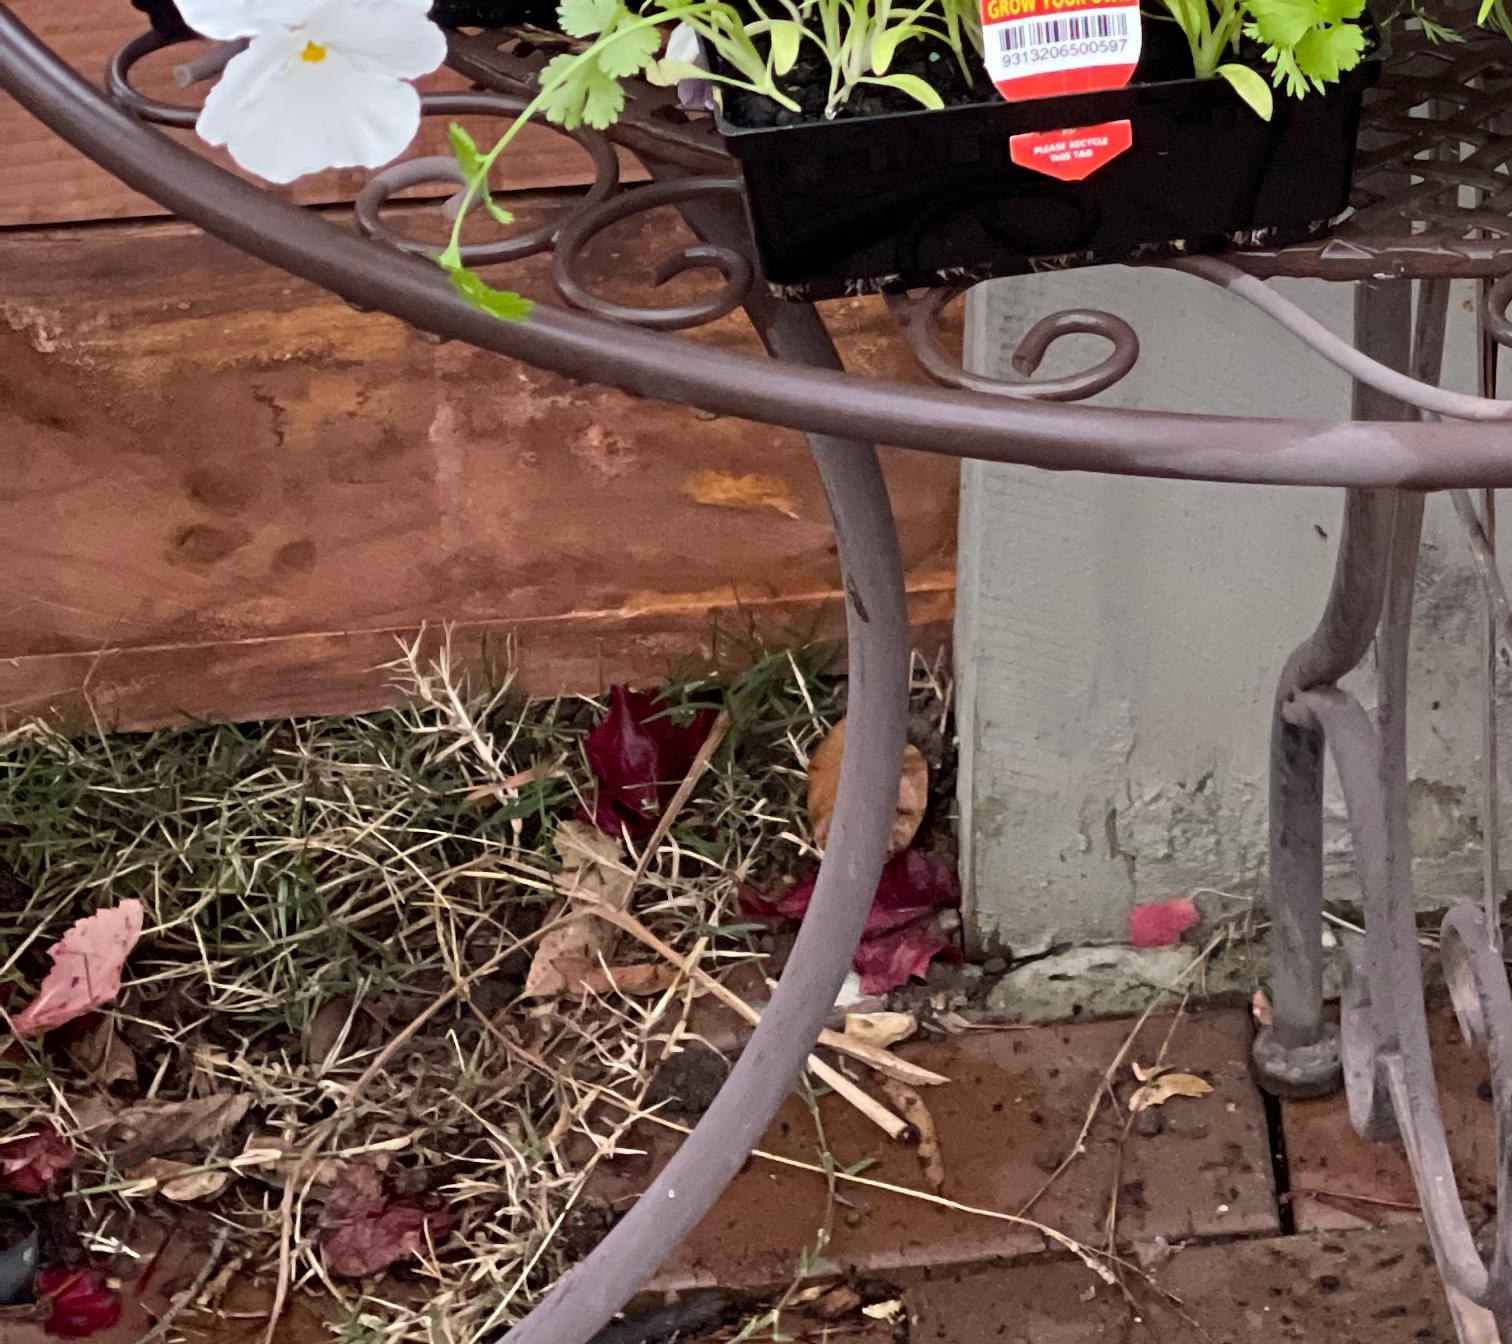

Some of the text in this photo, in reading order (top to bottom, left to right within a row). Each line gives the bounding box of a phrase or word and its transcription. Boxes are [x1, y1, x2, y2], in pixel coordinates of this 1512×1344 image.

[1001, 38, 1128, 68] 9313206500597
[1033, 136, 1109, 155] PLEASE RECYCLE
